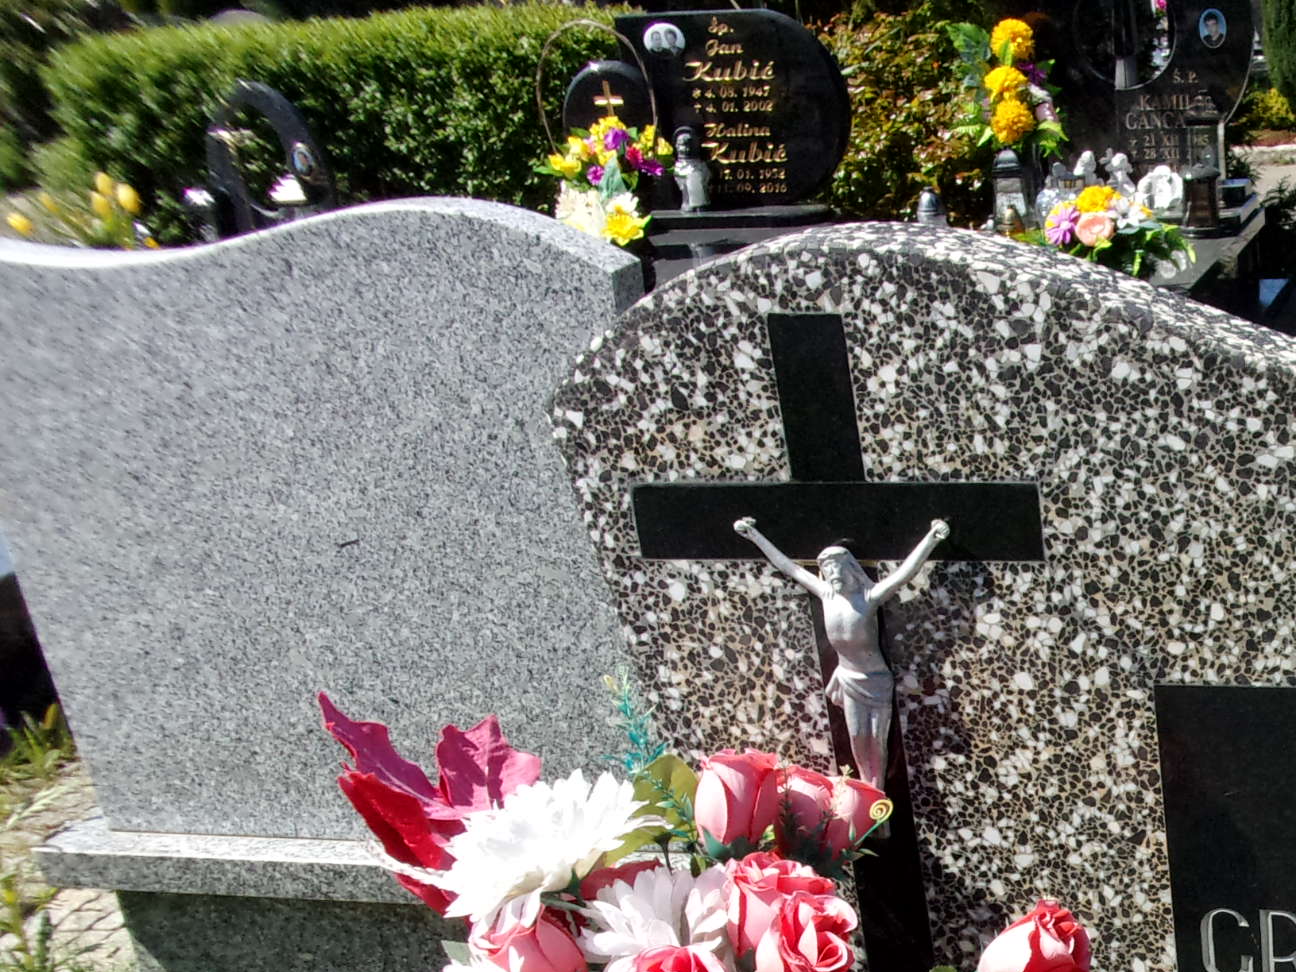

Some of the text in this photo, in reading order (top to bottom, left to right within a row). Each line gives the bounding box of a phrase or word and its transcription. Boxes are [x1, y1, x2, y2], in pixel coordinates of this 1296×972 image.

[705, 39, 744, 57] Jan
[682, 60, 776, 82] Kubić
[743, 100, 774, 112] 2002
[704, 122, 771, 138] Halina
[701, 141, 788, 164] Kubić
